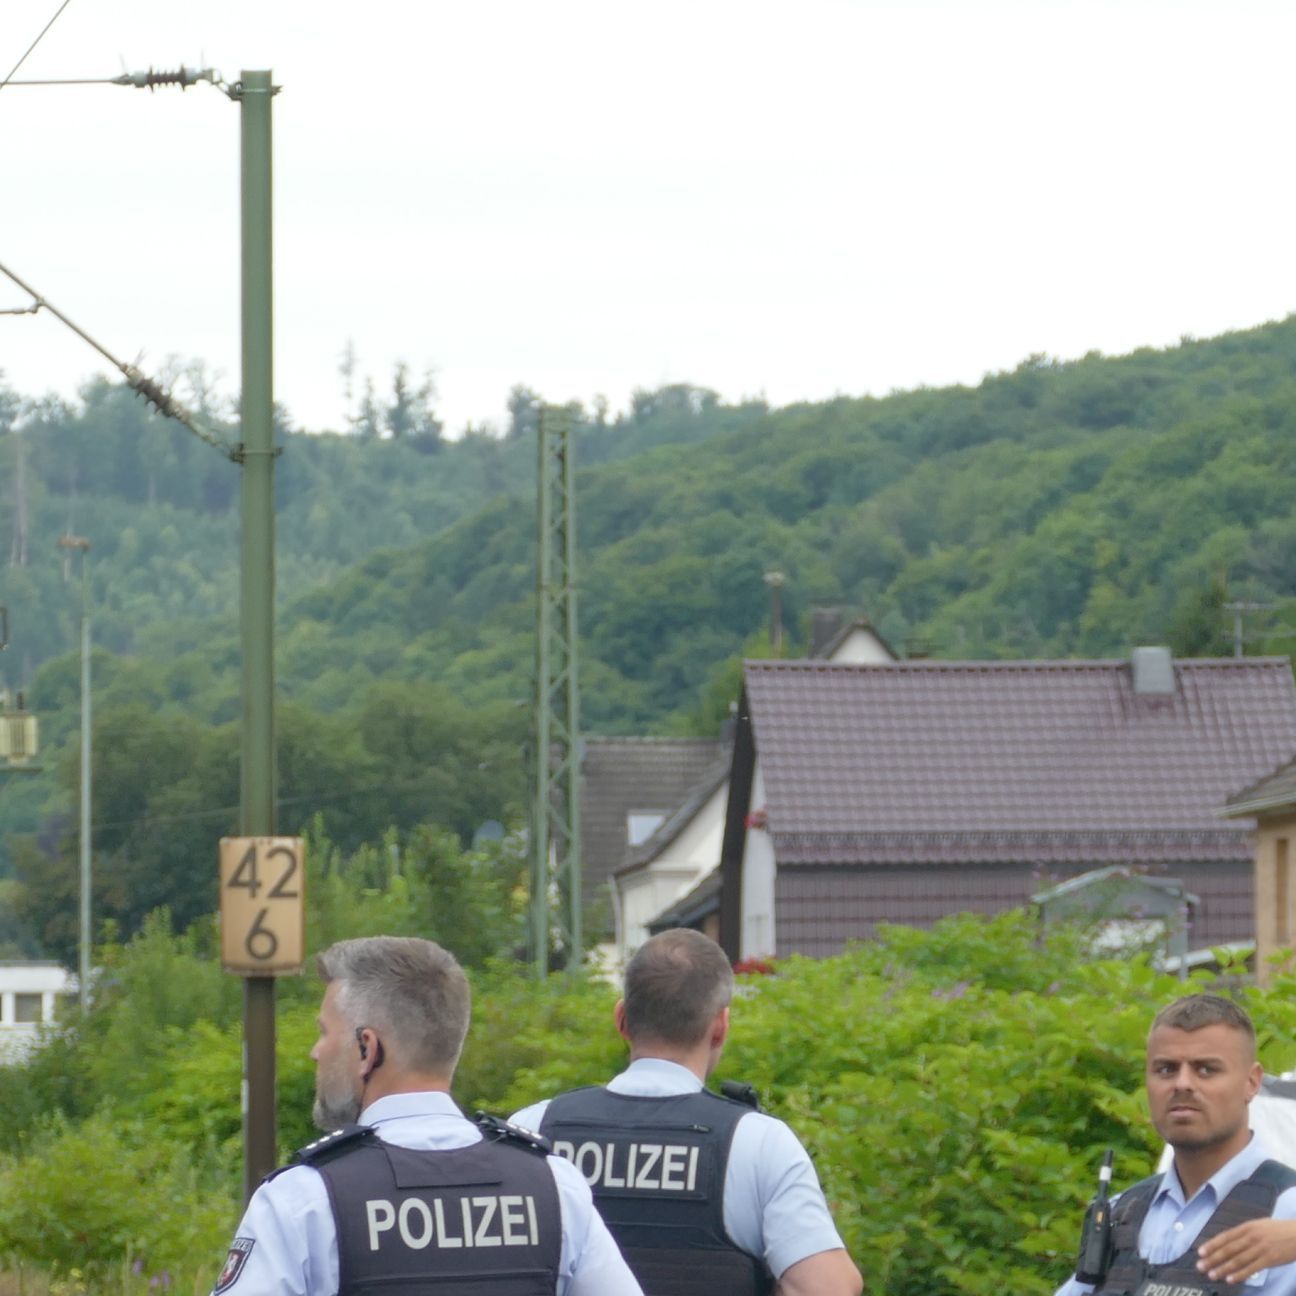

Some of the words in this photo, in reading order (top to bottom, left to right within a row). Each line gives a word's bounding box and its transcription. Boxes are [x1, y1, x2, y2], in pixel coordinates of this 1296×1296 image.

[227, 842, 299, 898] 42
[245, 906, 278, 960] 6
[366, 1195, 539, 1251] POLIZEI
